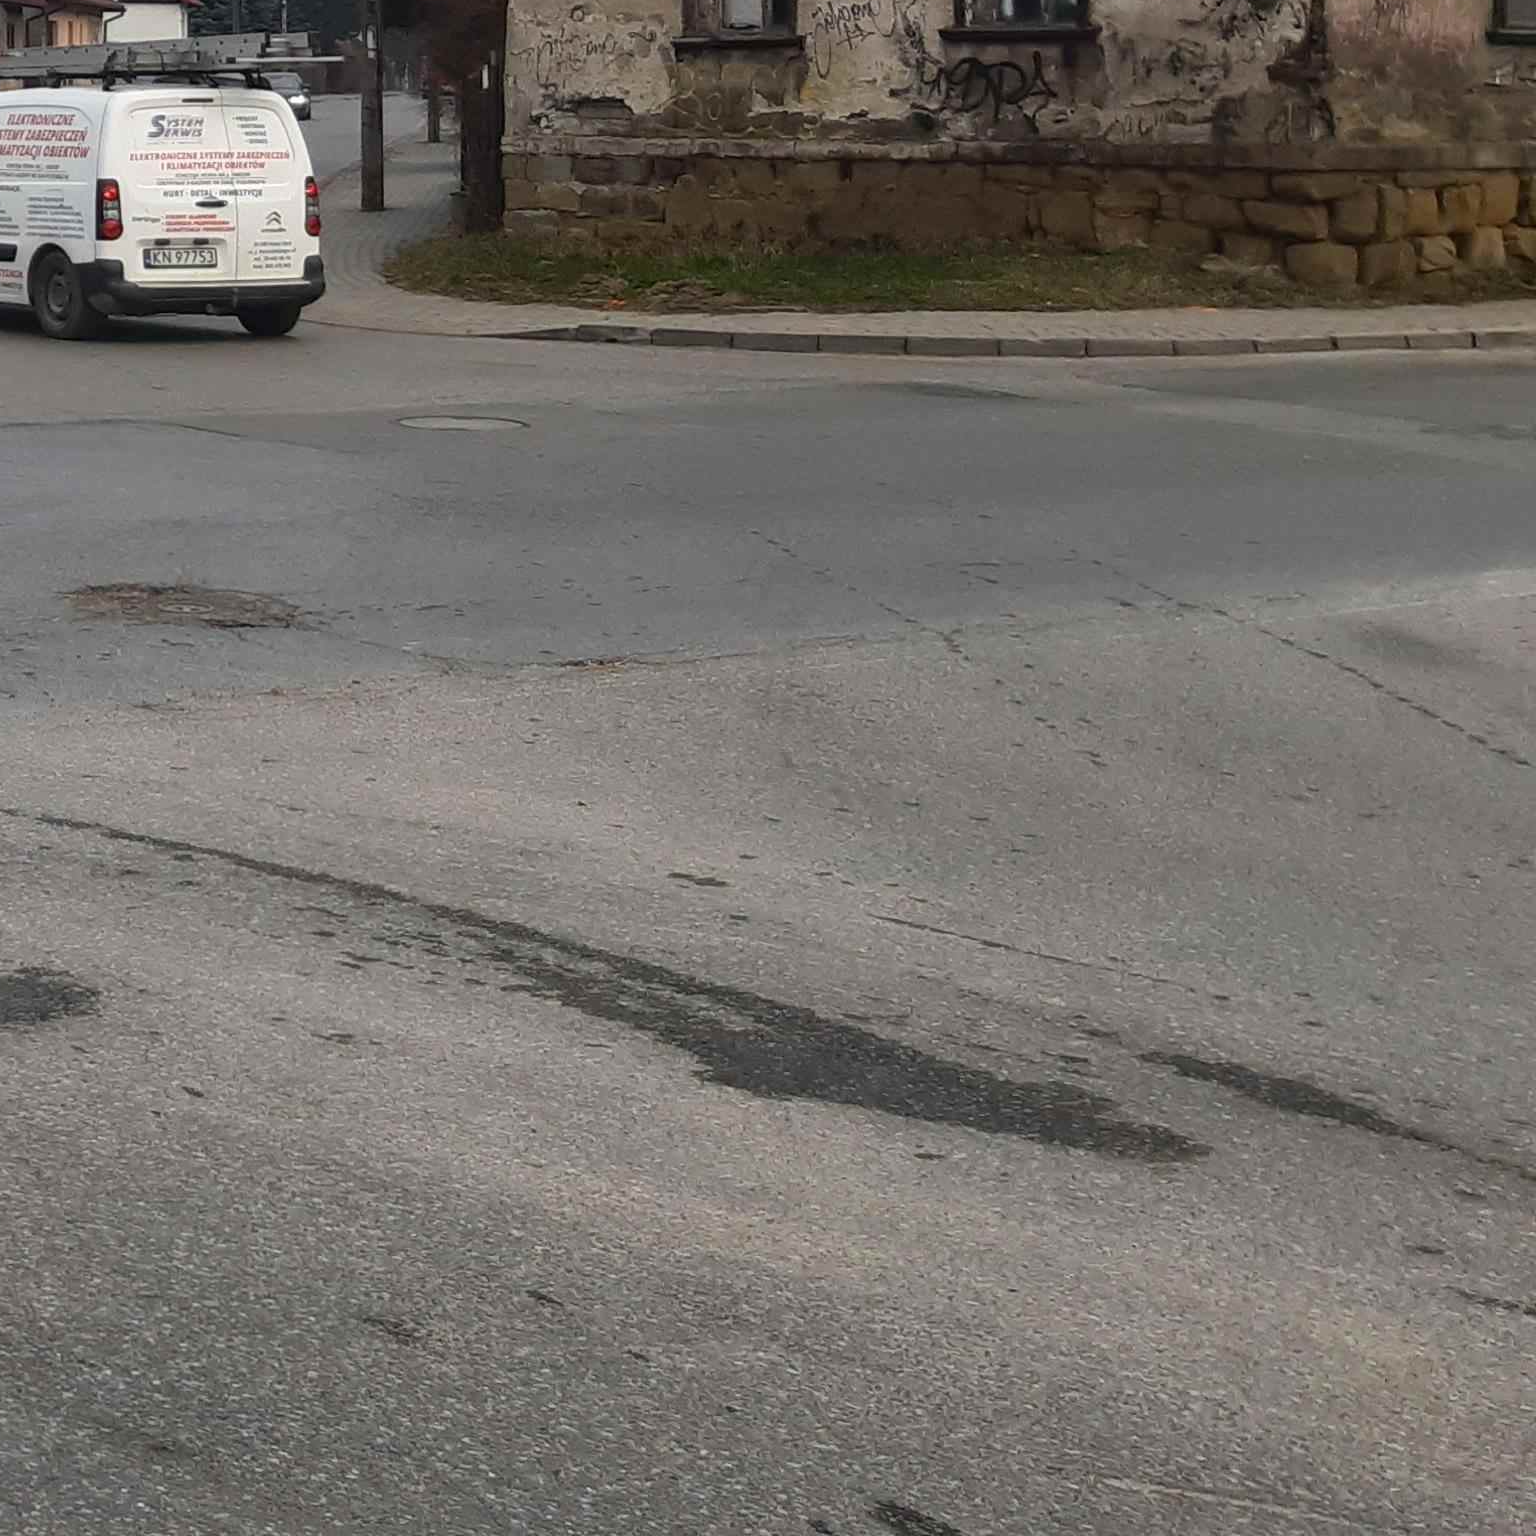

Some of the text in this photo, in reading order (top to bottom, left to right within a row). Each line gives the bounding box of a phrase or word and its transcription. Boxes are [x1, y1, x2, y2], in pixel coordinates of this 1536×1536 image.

[7, 114, 75, 125] ELEKTRONICZNE
[129, 152, 198, 161] ELEKTRONICZNE
[199, 152, 234, 160] SYSTEMY
[166, 163, 222, 172] KLIMATYZACJI
[153, 250, 214, 264] KN 97753
